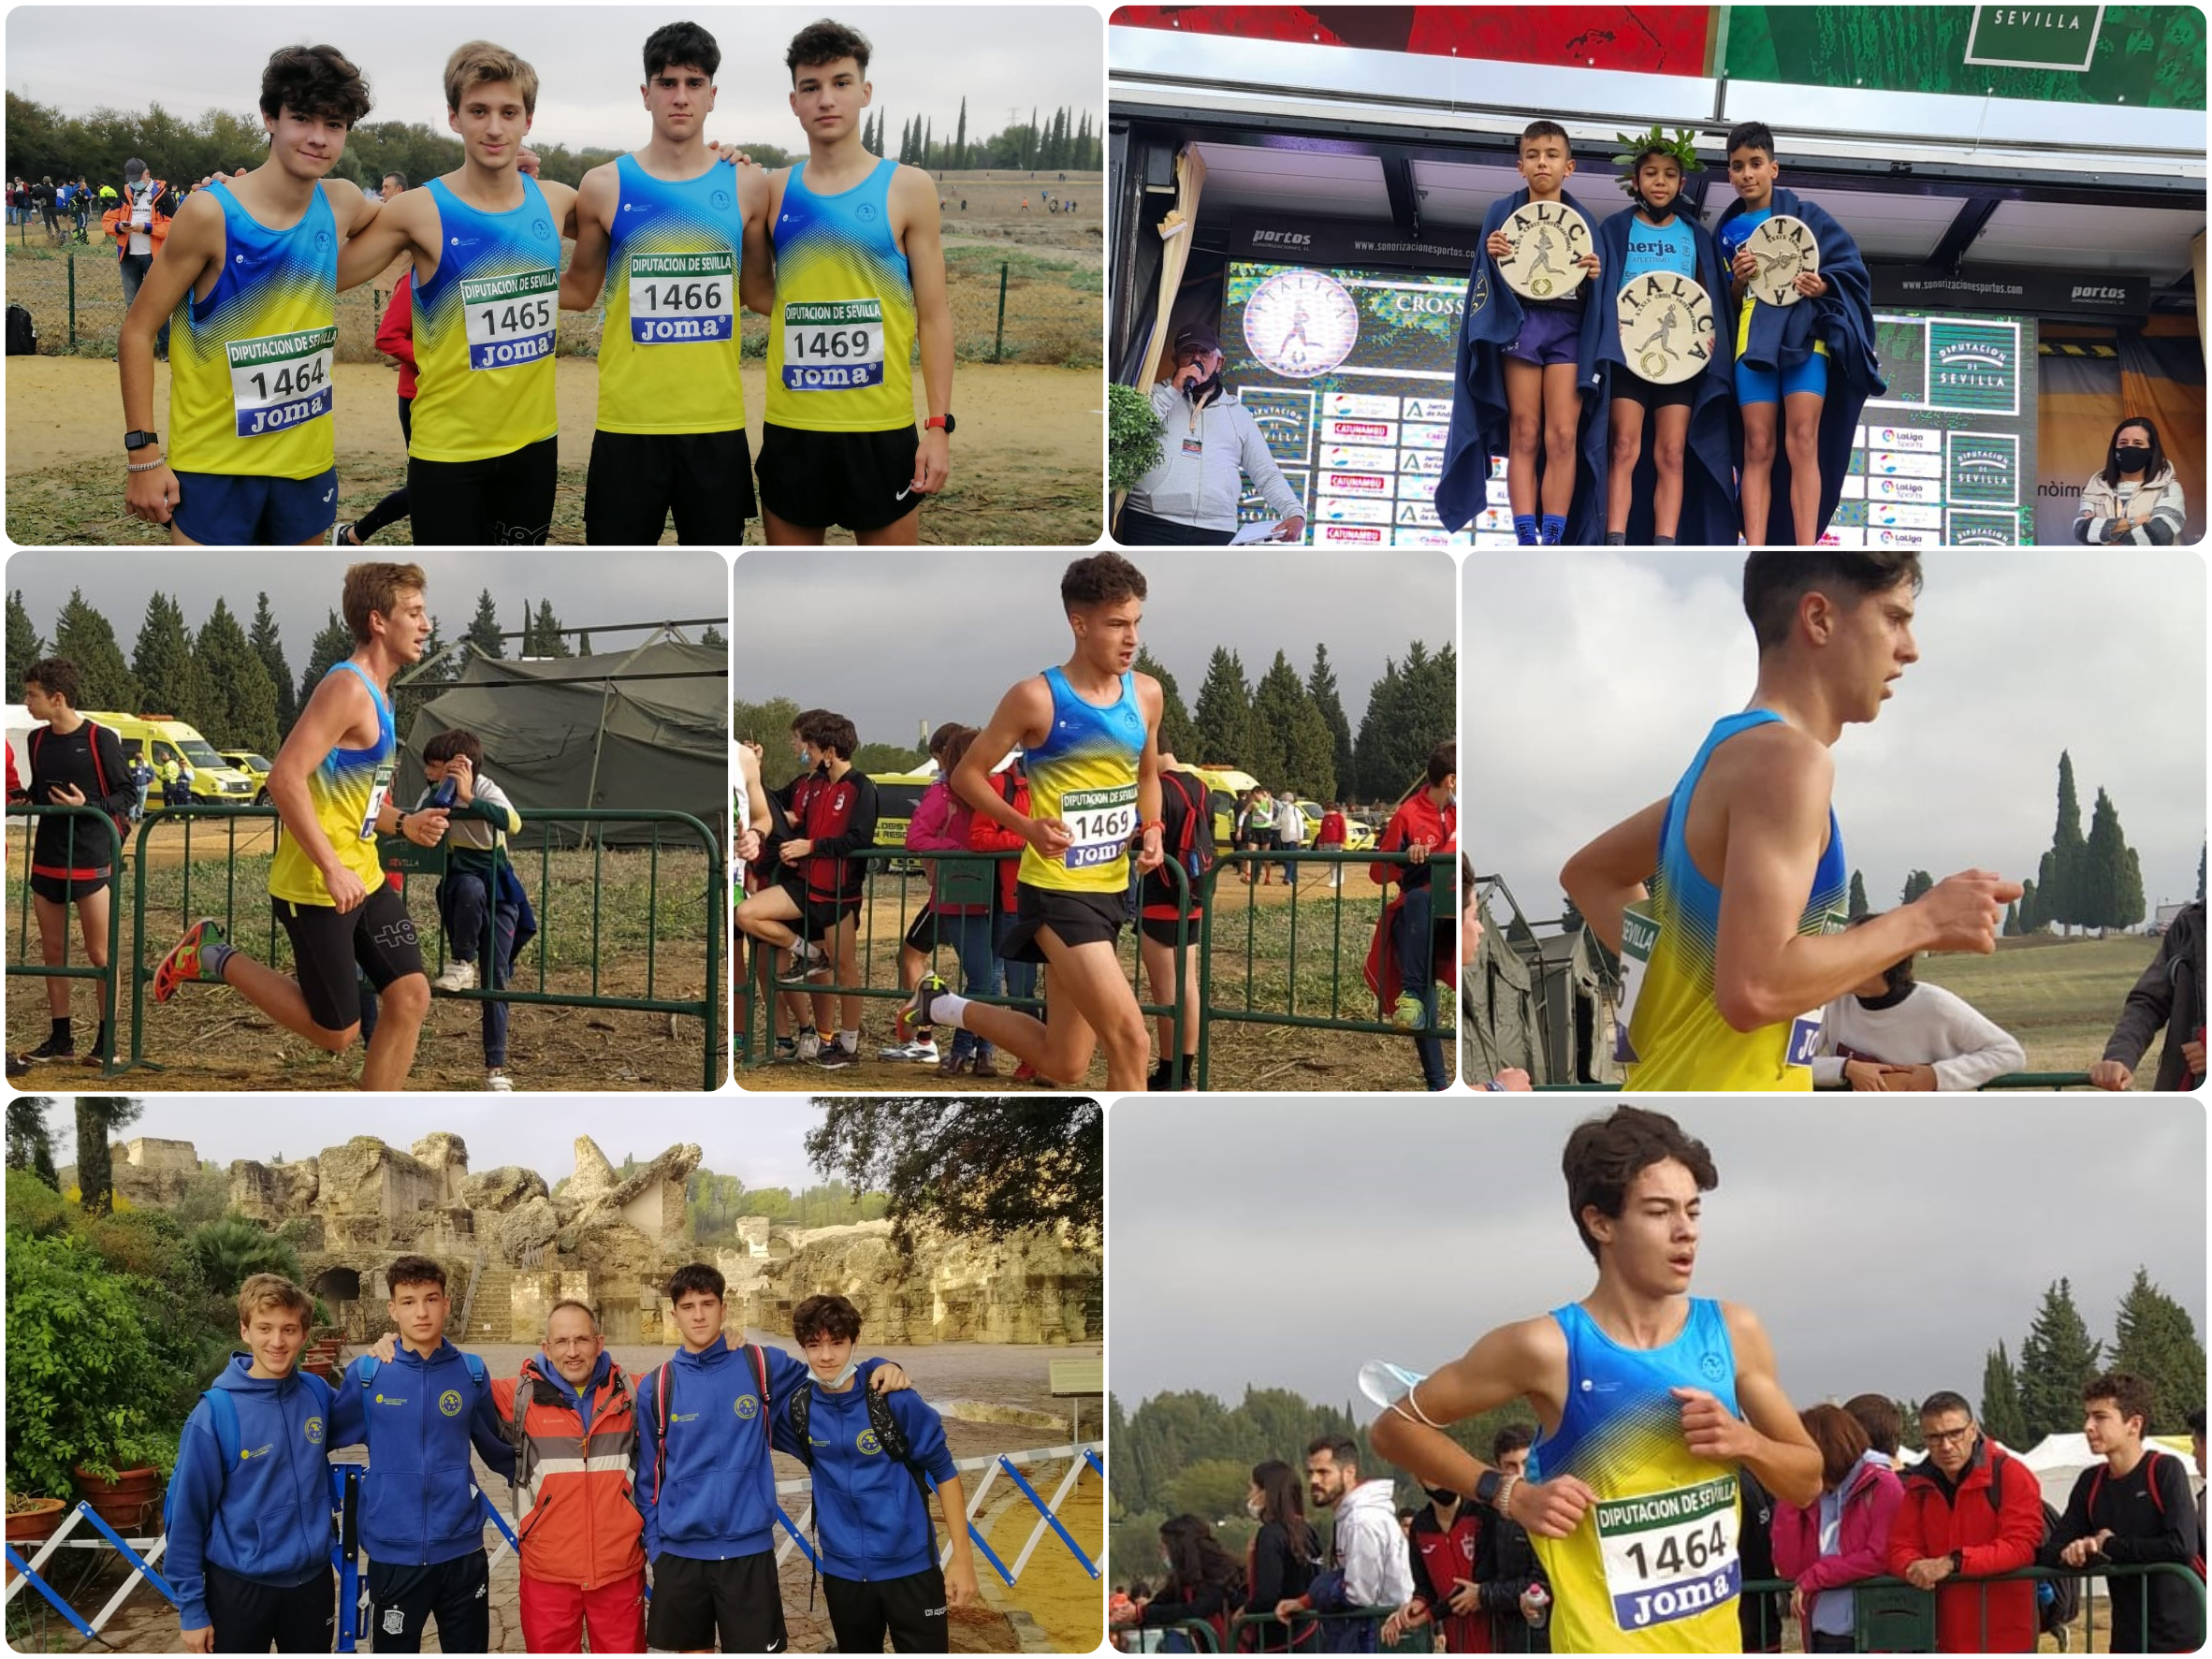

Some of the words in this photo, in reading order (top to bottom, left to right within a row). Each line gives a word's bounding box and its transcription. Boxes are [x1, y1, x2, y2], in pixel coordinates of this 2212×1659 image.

[1994, 9, 2080, 29] SEVILLA
[1252, 230, 1311, 245] portos
[1355, 240, 1477, 258] www.sonorizacionesportos.co
[633, 257, 685, 272] DIPUTACION
[688, 257, 700, 271] DE
[701, 255, 731, 270] SEVILLA
[464, 279, 518, 298] DIPUTACION
[519, 277, 529, 290] DE
[530, 272, 557, 289] SEVILLA
[2071, 286, 2125, 298] portos
[644, 283, 721, 310] 1466
[1396, 296, 1465, 314] CROSS
[481, 299, 550, 335] 1465
[786, 306, 831, 320] DIPUTACION
[833, 306, 844, 319] DE
[846, 304, 881, 319] SEVILLA
[1619, 275, 1715, 360] ITALICA
[231, 339, 293, 362] DIPUTACION
[294, 336, 308, 352] DE
[309, 330, 337, 349] SEVILLA
[794, 330, 869, 358] 1469
[1939, 343, 2007, 361] DIPUTACION
[250, 357, 324, 400] 1464
[1940, 373, 2004, 387] SEVILLA
[1263, 432, 1300, 442] VILLA
[1897, 432, 1923, 441] LaLiga
[1957, 451, 2009, 465] DIPUTACION
[1332, 477, 1382, 488] CATUNAMBU
[1958, 474, 2007, 484] SEVILLA
[1896, 483, 1923, 493] LaLiga
[1329, 529, 1378, 540] CATUNAMBU
[1895, 535, 1922, 543] LaLiga
[1957, 528, 2008, 542] DIPUTACION
[1063, 793, 1108, 807] DIPUTACION
[1110, 792, 1118, 803] DE
[1076, 810, 1128, 840] 1469
[1600, 1498, 1680, 1528] DIPUTACION
[1681, 1492, 1699, 1513] DE
[1699, 1481, 1736, 1510] SEVILLA
[1625, 1521, 1726, 1579] 1464
